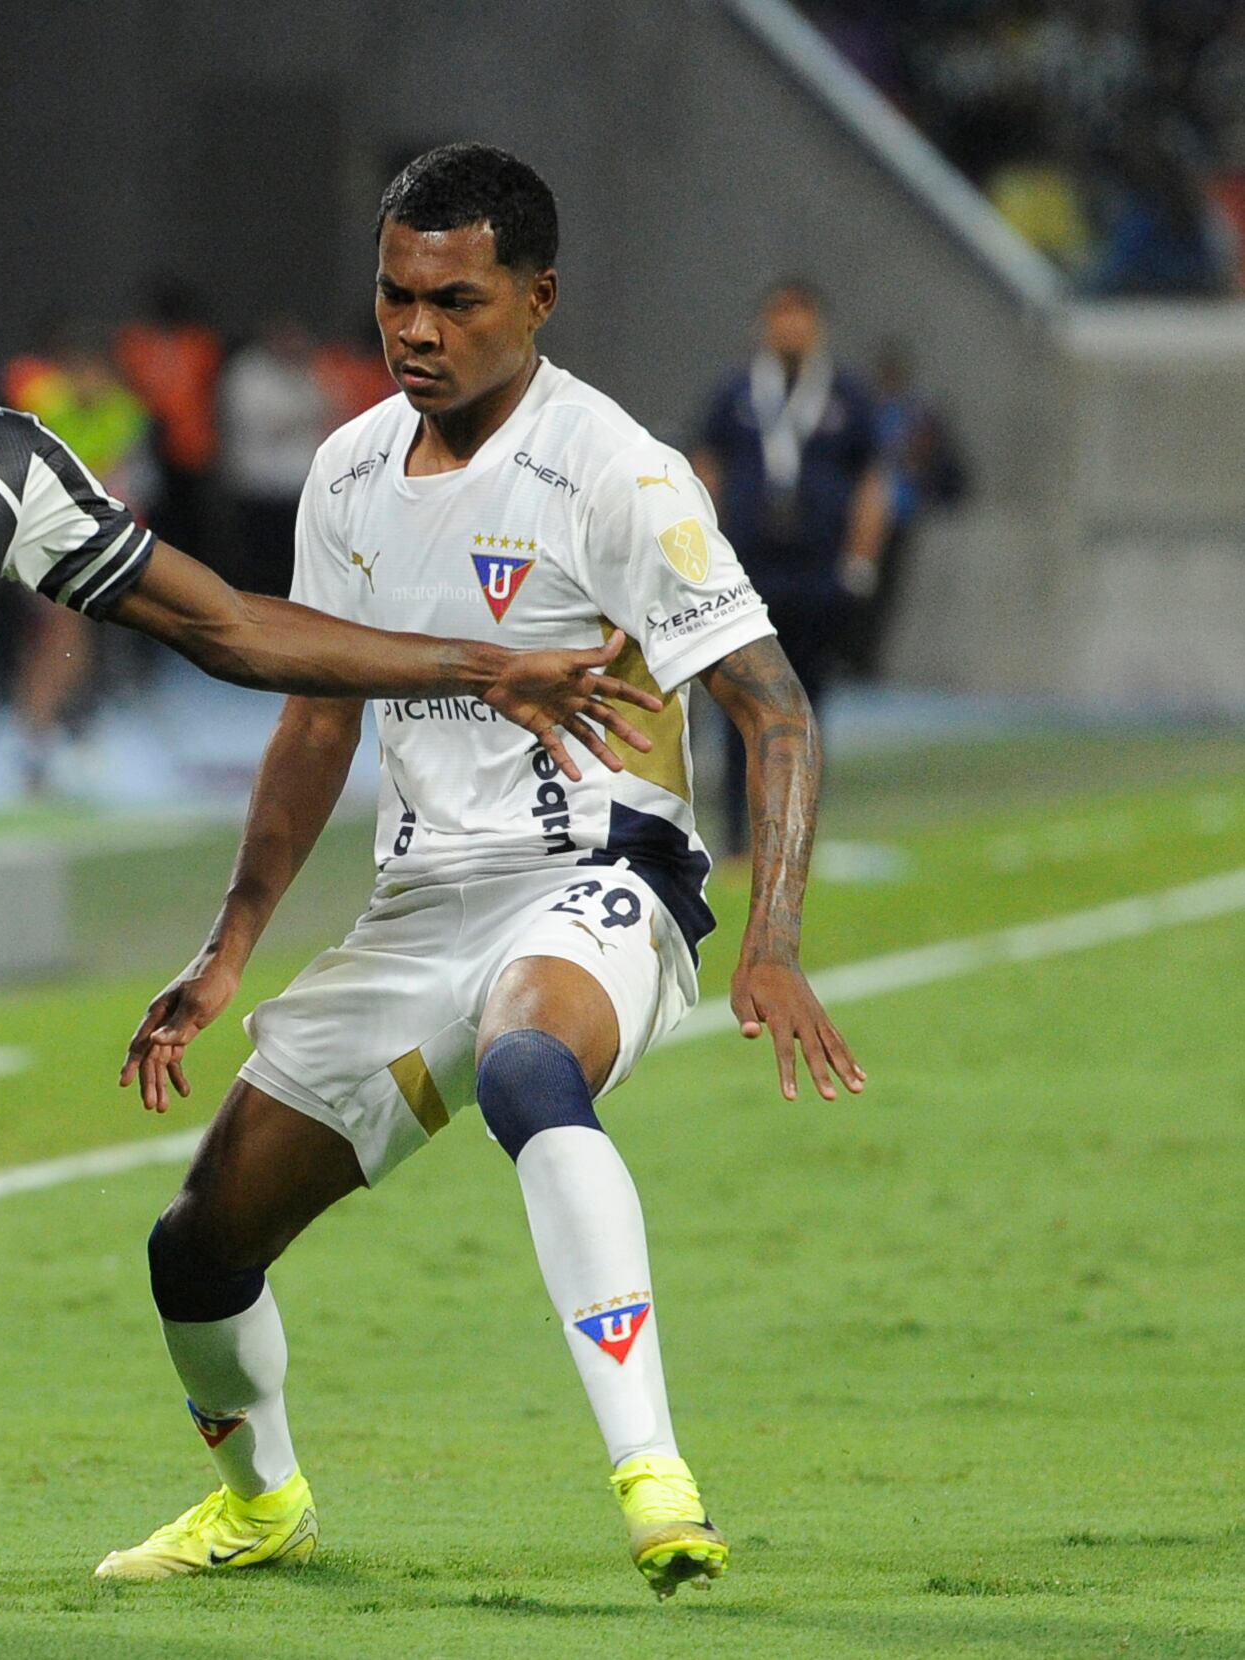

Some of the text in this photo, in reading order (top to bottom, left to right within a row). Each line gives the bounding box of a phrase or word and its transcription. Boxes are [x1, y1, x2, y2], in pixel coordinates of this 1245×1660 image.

[513, 451, 580, 498] CHERY
[488, 563, 513, 600] U
[546, 880, 642, 929] 29
[599, 1312, 633, 1343] U
